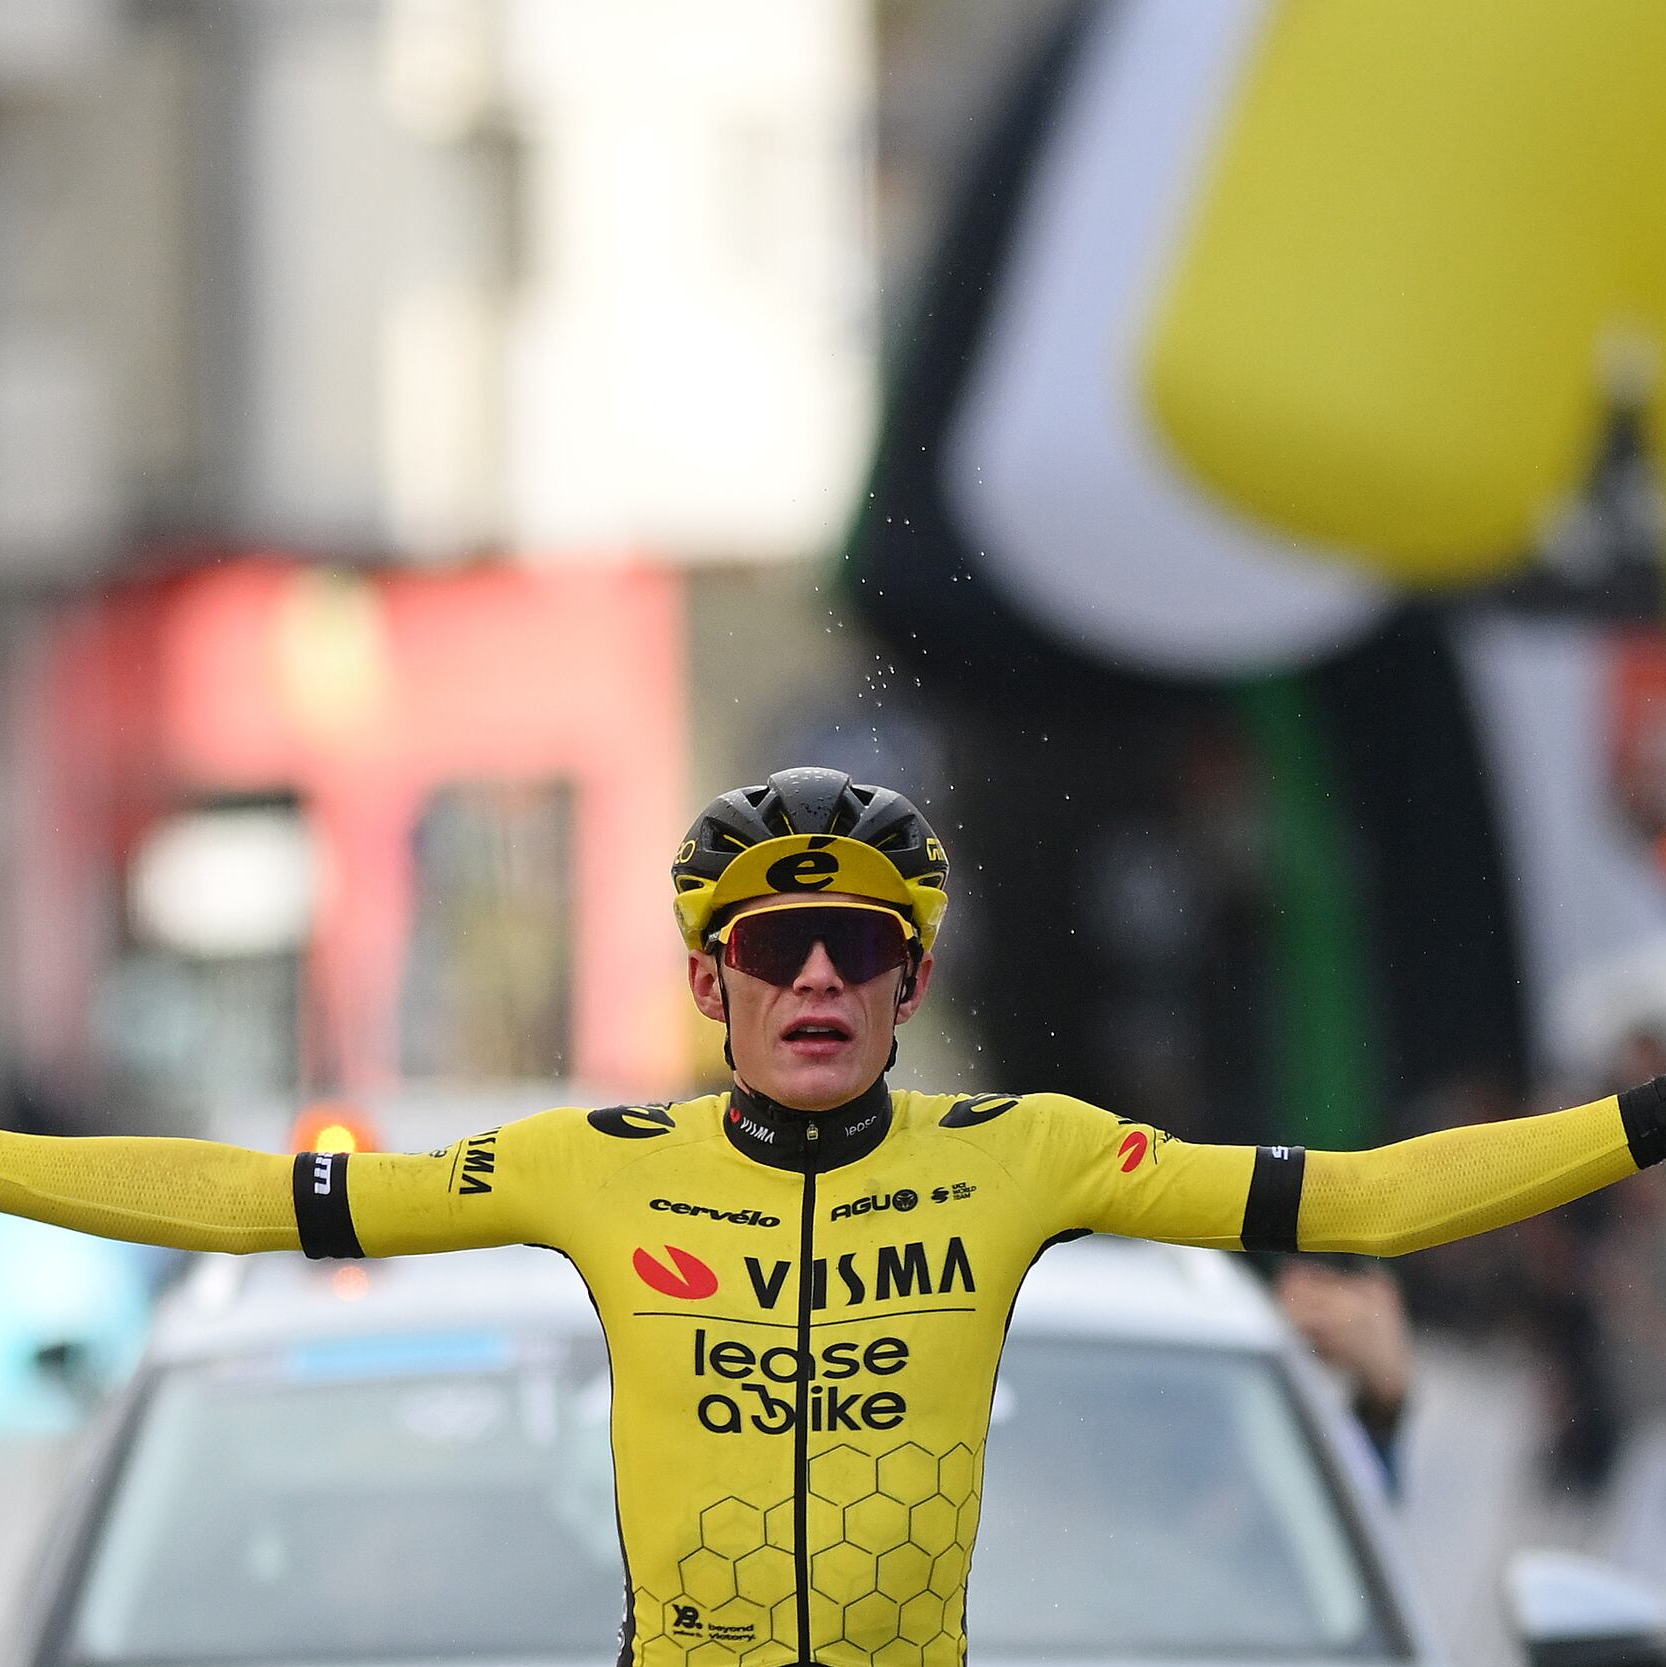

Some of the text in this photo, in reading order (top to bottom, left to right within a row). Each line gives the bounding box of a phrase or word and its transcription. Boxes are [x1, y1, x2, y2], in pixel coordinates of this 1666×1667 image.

[740, 1117, 776, 1144] VISMA
[460, 1127, 502, 1195] ISMA
[649, 1198, 780, 1228] cervélo
[831, 1194, 890, 1222] AGU
[744, 1237, 976, 1311] VISMA
[694, 1329, 910, 1384] lease
